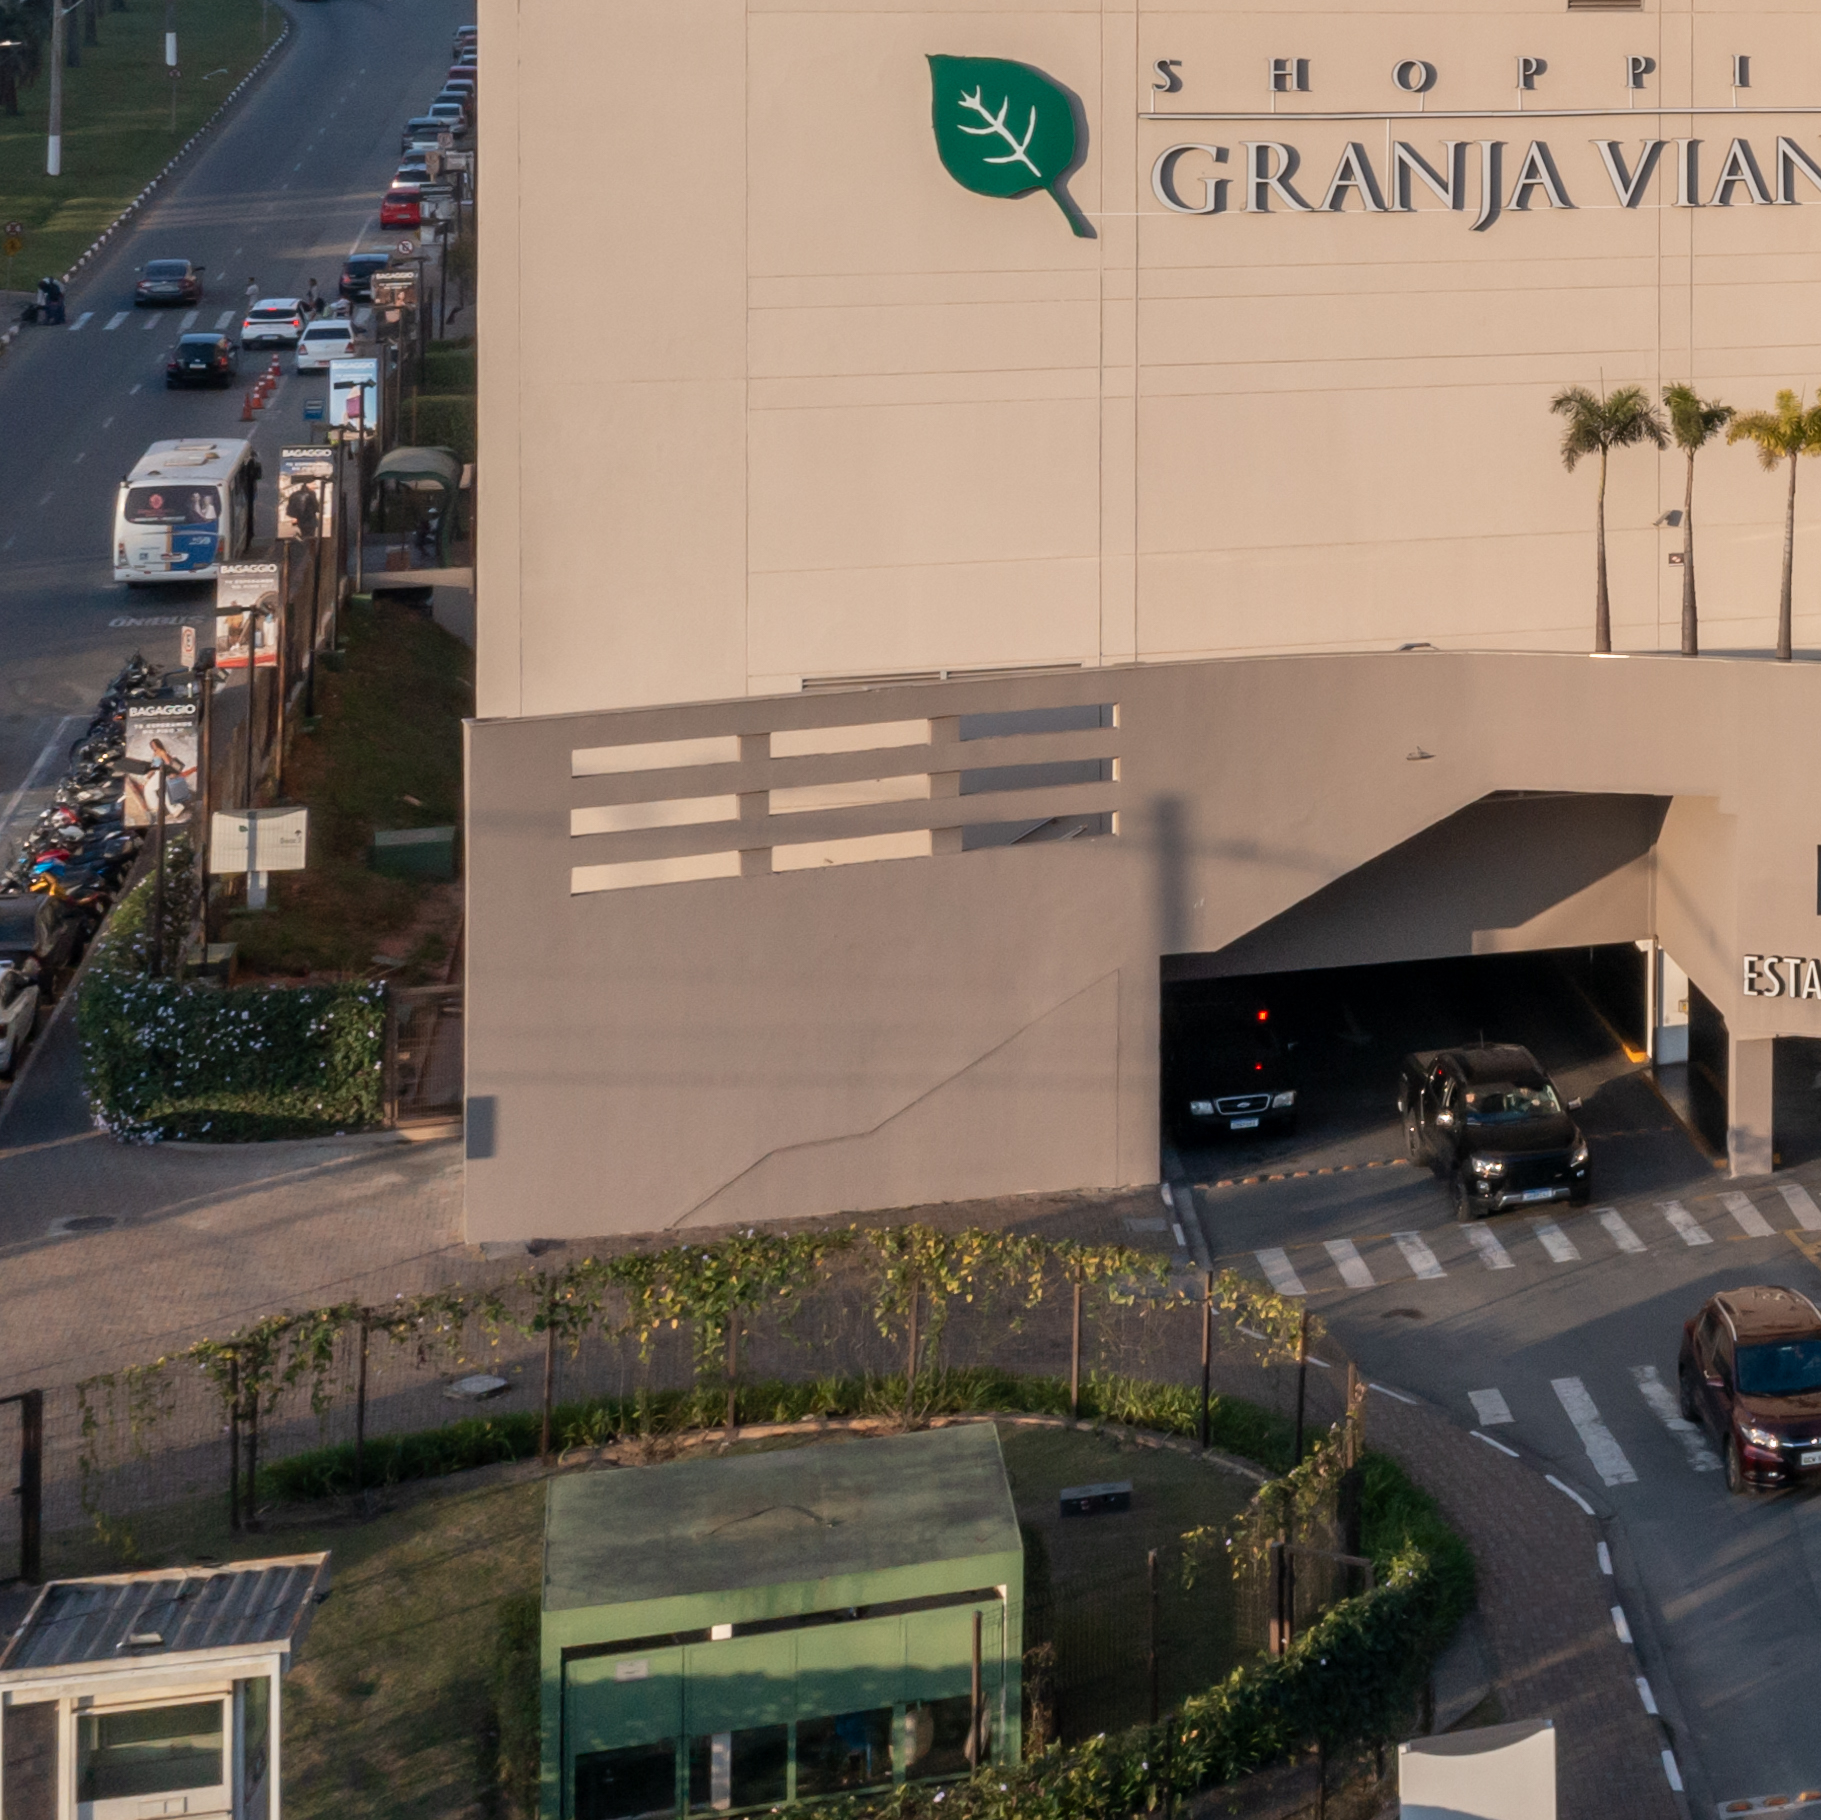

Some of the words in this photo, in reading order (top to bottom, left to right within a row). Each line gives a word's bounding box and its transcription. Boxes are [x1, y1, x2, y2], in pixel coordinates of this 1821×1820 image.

[1151, 140, 1576, 232] GRANJA
[282, 448, 332, 458] BAGAGGIO
[220, 563, 278, 574] BAGAGGIO
[129, 703, 197, 718] BAGAGGIO
